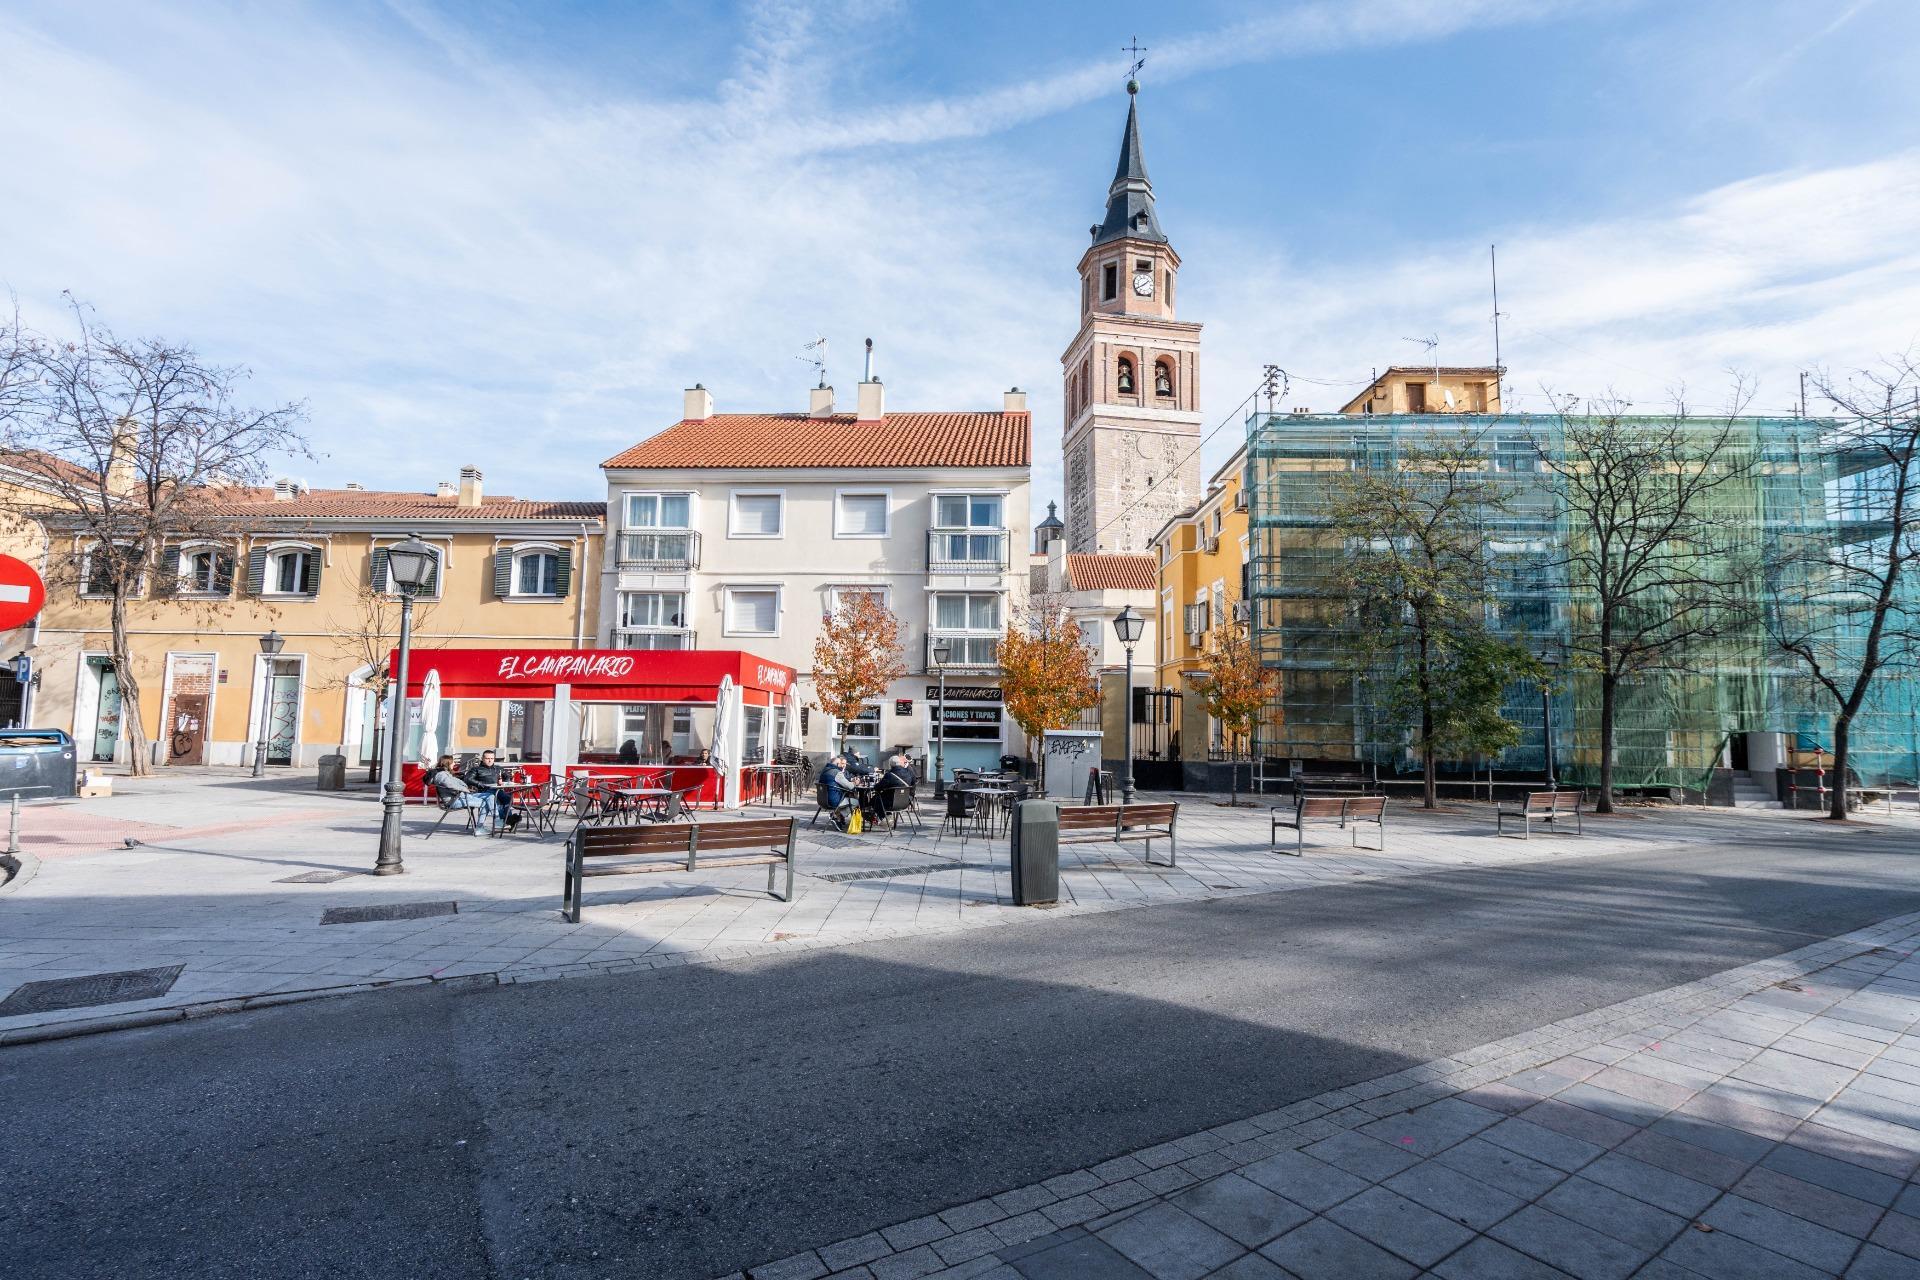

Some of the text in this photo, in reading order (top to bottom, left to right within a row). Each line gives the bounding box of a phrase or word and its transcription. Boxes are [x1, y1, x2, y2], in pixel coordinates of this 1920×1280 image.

[20, 659, 28, 679] P
[498, 654, 634, 679] EL CAMPANARIO
[970, 711, 975, 719] Y
